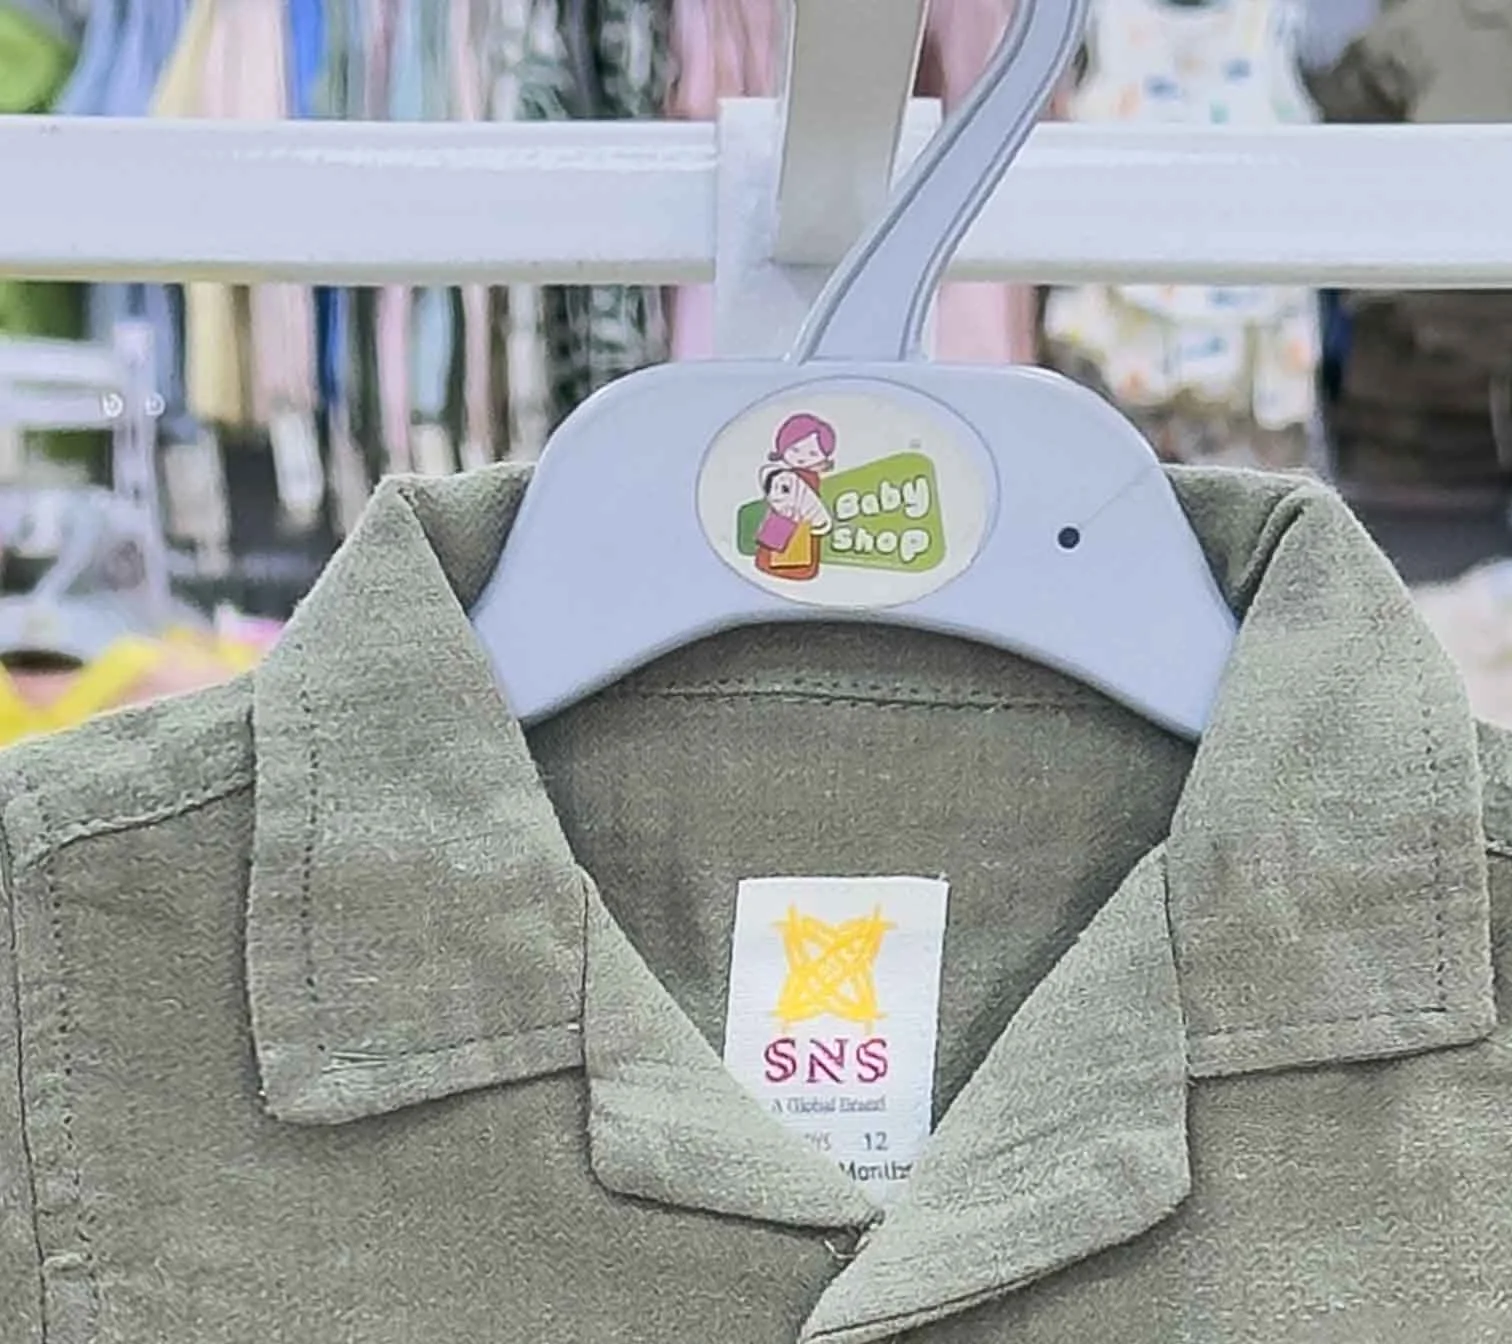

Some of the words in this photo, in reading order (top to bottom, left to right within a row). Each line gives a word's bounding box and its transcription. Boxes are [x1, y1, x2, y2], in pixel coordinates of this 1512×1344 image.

[834, 475, 930, 519] Baby
[831, 527, 931, 563] Shop
[764, 1038, 888, 1082] SNS
[864, 1131, 888, 1151] 12
